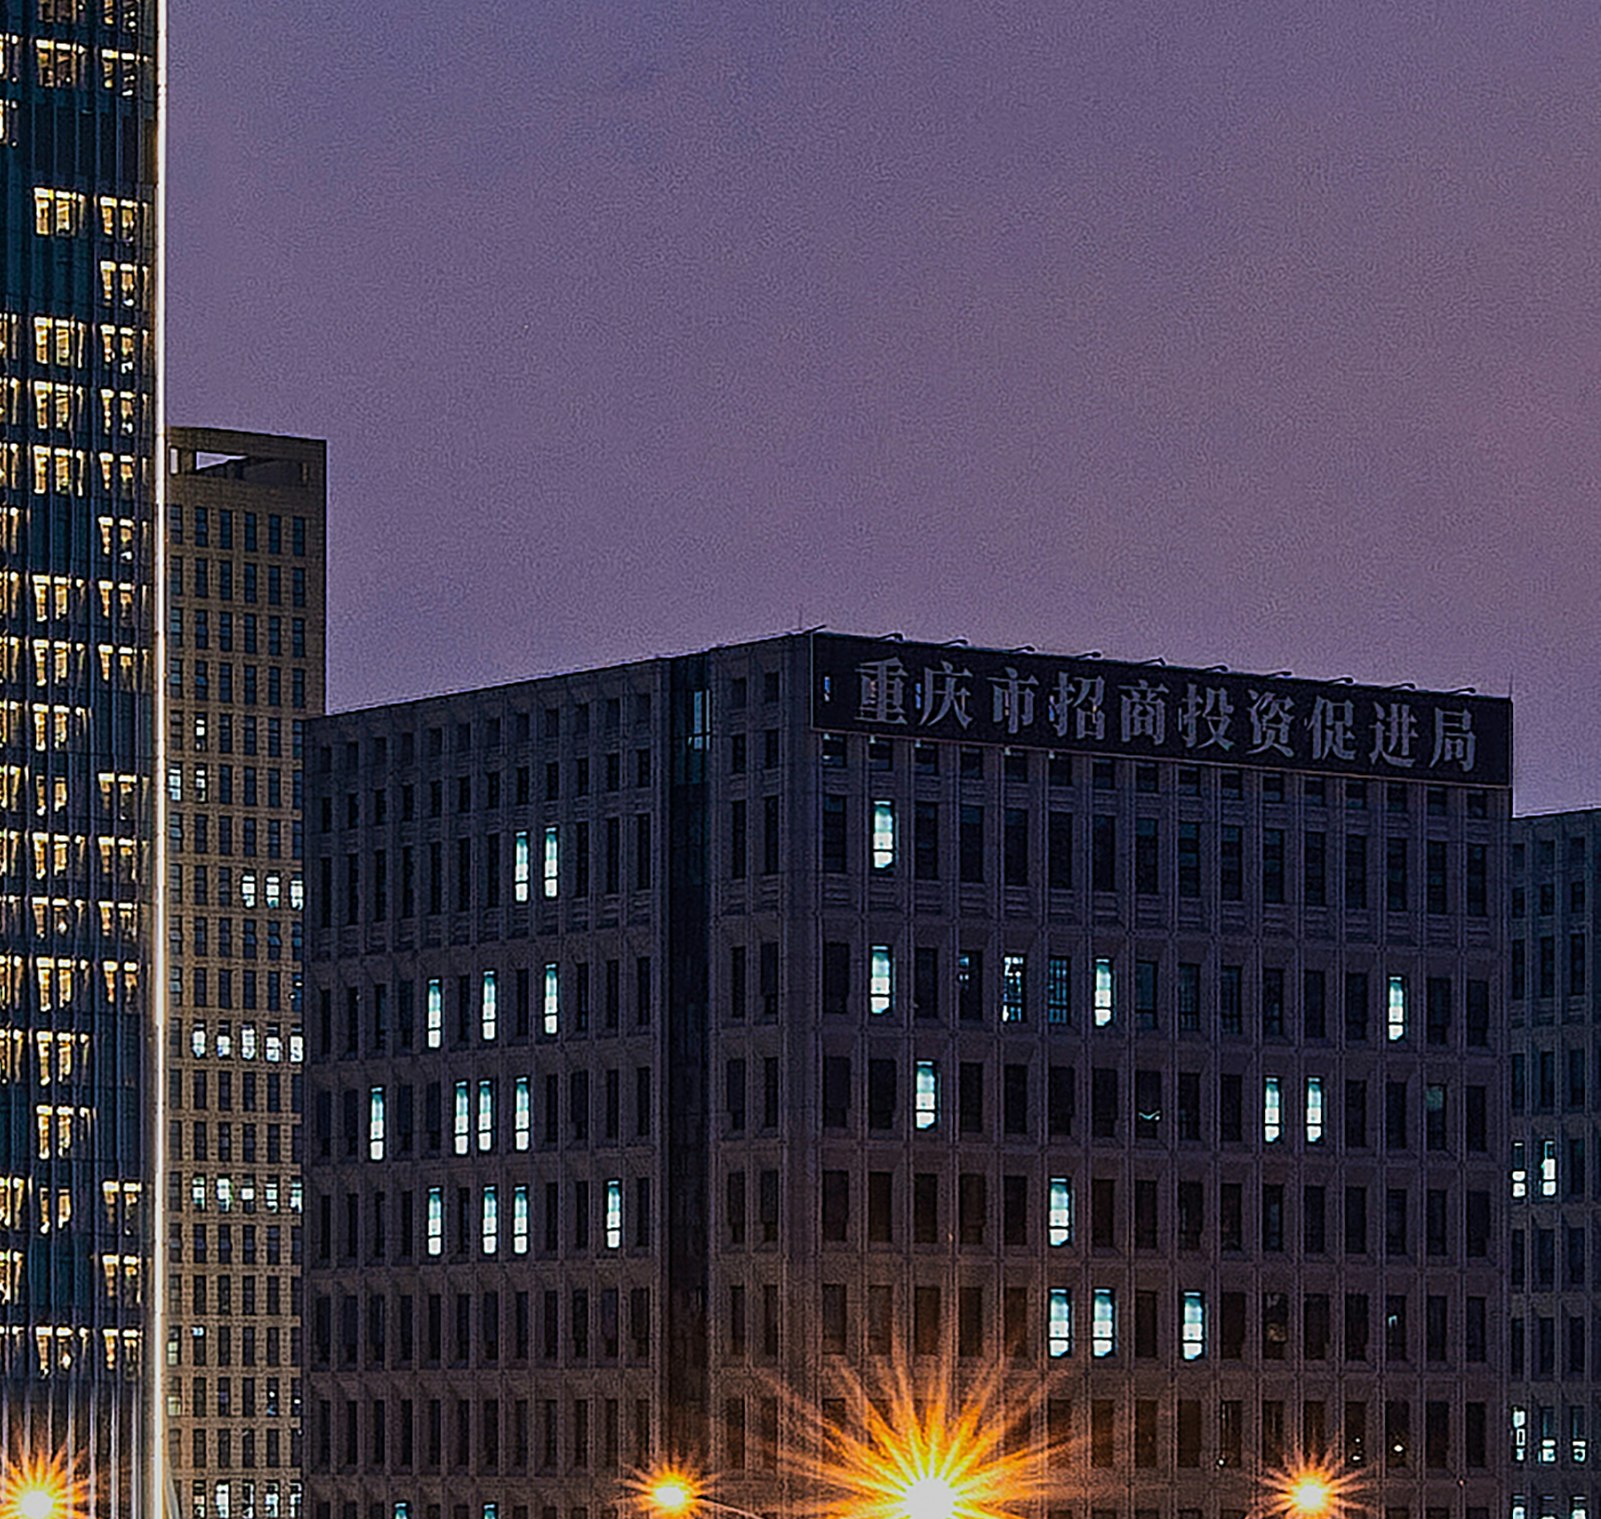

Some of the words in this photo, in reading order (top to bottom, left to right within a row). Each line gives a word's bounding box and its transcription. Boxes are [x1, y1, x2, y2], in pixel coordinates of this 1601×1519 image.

[854, 656, 1477, 773] 重庆市招商投资促进局
